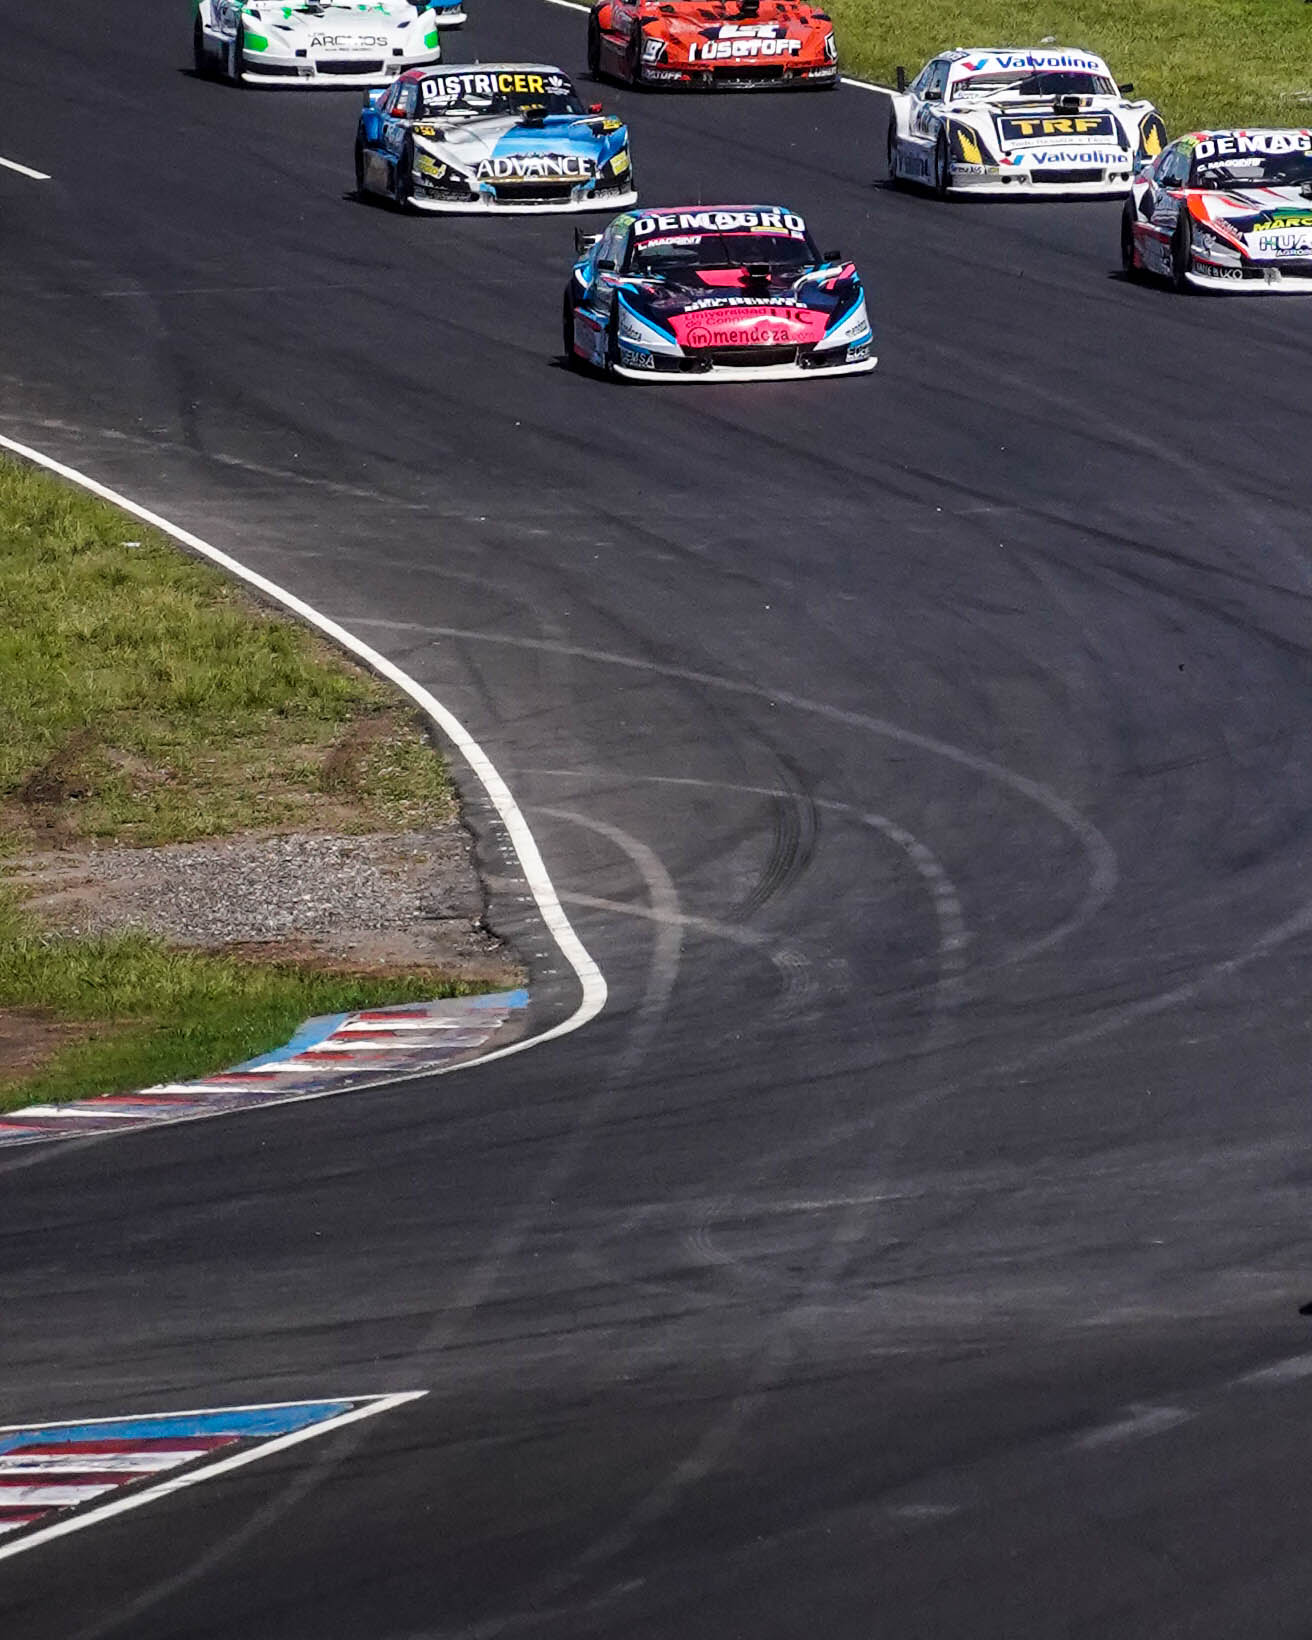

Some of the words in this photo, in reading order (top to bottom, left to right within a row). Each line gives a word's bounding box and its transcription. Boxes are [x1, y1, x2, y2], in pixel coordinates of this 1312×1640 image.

[996, 57, 1099, 71] Valvoline
[421, 74, 546, 98] DISTRICER
[1011, 118, 1102, 137] TRF
[476, 156, 592, 179] ADVANCE
[1032, 152, 1128, 165] Valvoline
[634, 214, 805, 236] DEMAGRO
